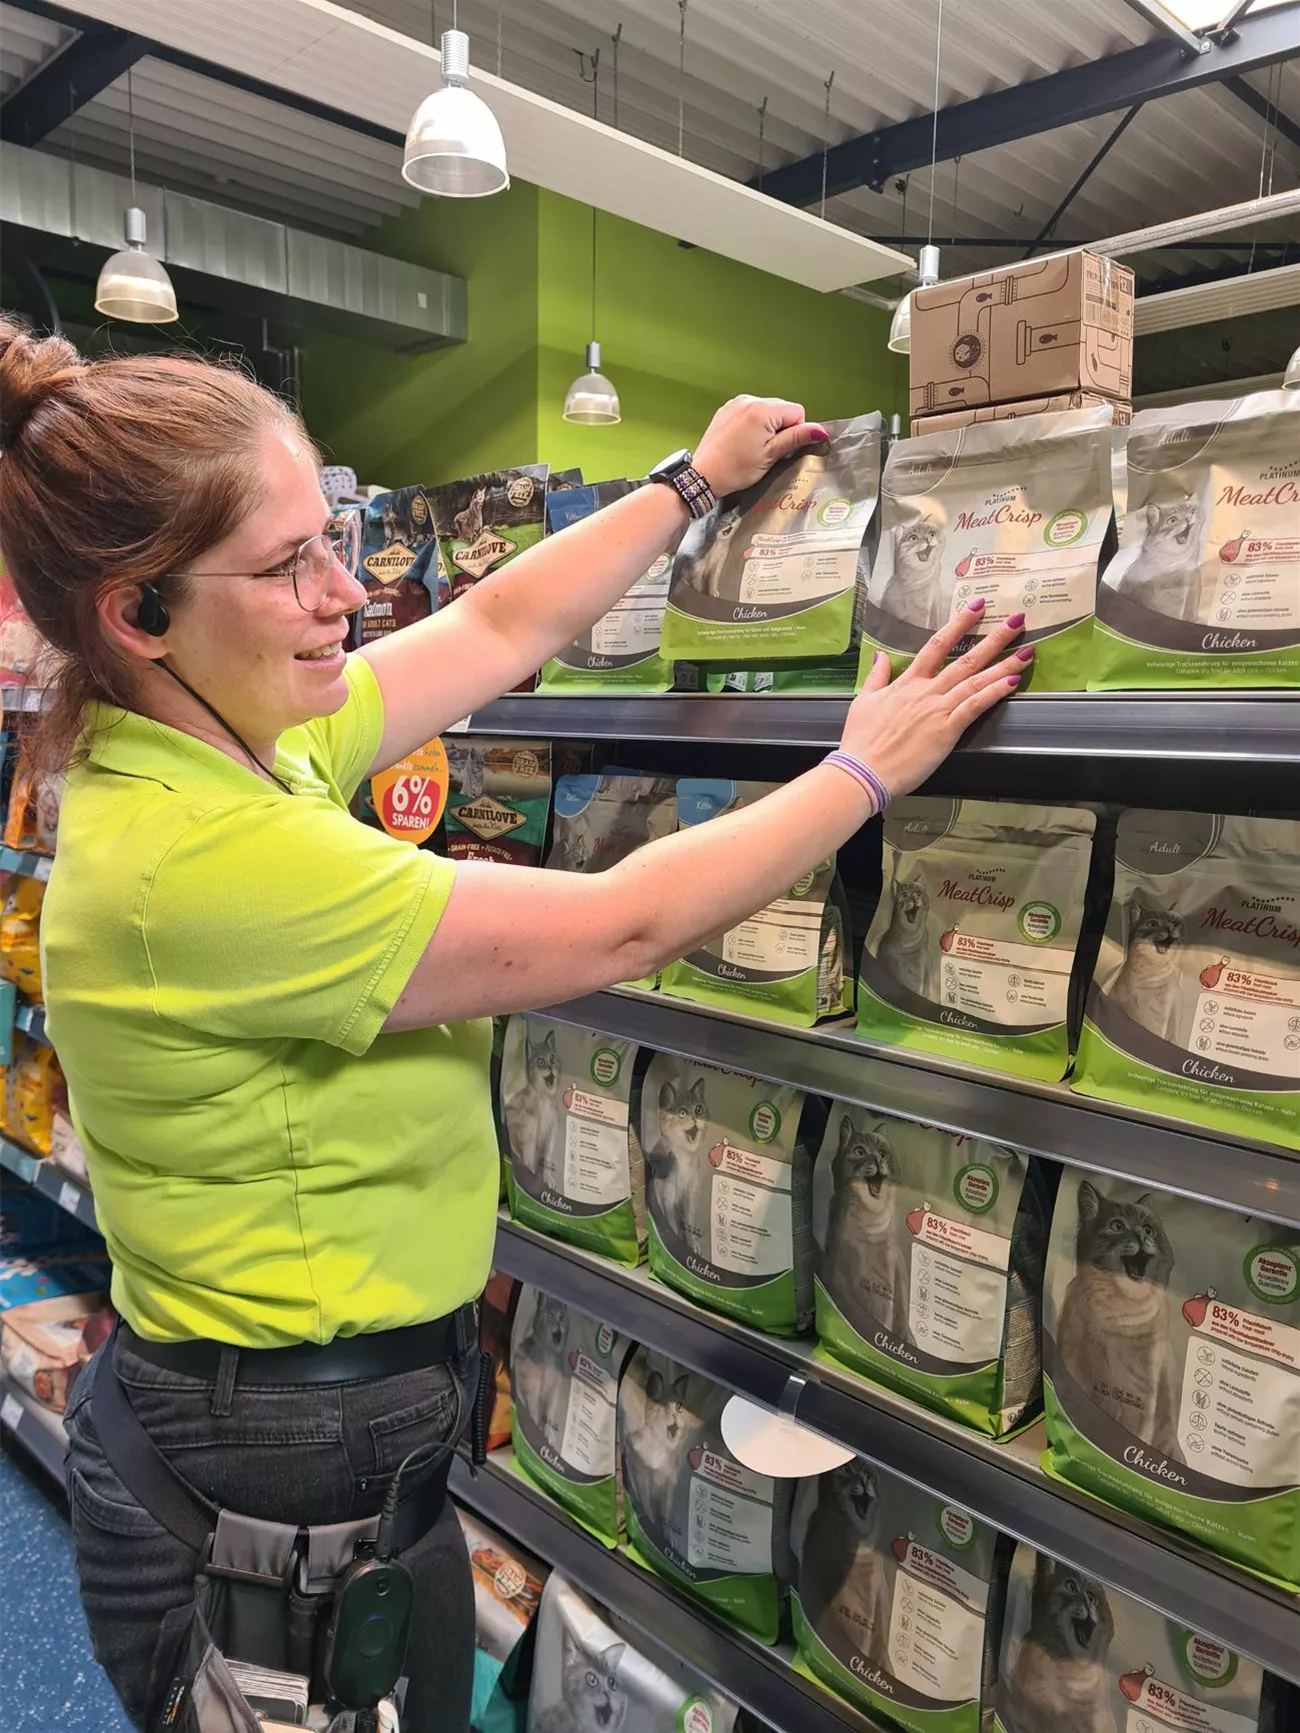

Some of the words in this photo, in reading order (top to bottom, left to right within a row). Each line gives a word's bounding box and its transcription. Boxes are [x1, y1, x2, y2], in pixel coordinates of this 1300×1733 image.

[1158, 431, 1190, 446] Adult
[984, 494, 1017, 506] PLATINUM
[1216, 482, 1300, 506] MeatCr
[953, 504, 1043, 533] MeatCrisp
[455, 542, 506, 560] CARNILOVE
[760, 548, 777, 557] 83%
[1248, 541, 1273, 552] 83%
[975, 556, 995, 567] 83%
[732, 606, 768, 620] Chicken
[1202, 632, 1258, 649] Chicken
[392, 775, 432, 815] 6%
[392, 813, 430, 829] SPAREN!
[458, 807, 518, 825] CARNILOVE
[1149, 840, 1182, 854] Adult
[937, 880, 1016, 912] MeatCrisp
[1241, 900, 1282, 914] PLATINUM
[957, 937, 976, 949] 83%
[717, 963, 746, 980] Chicken
[1226, 971, 1252, 986] 83%
[940, 1010, 979, 1030] Chicken
[1181, 1059, 1236, 1084] Chicken
[726, 1149, 743, 1165] 83%
[540, 1190, 573, 1213] Chicken
[926, 1217, 948, 1235] 83%
[686, 1255, 721, 1281] Chicken
[1258, 1257, 1293, 1272] Akzeptanz
[1260, 1264, 1288, 1278] Garantie
[1257, 1271, 1290, 1286] Acceptance
[1212, 1305, 1240, 1327] 83%
[874, 1332, 920, 1364] Chicken
[704, 1454, 724, 1471] 83%
[1123, 1445, 1189, 1487] Chicken
[663, 1546, 697, 1580] Chicken
[910, 1545, 934, 1566] 83%
[849, 1655, 896, 1695] Chicken
[1147, 1683, 1176, 1707] 83%
